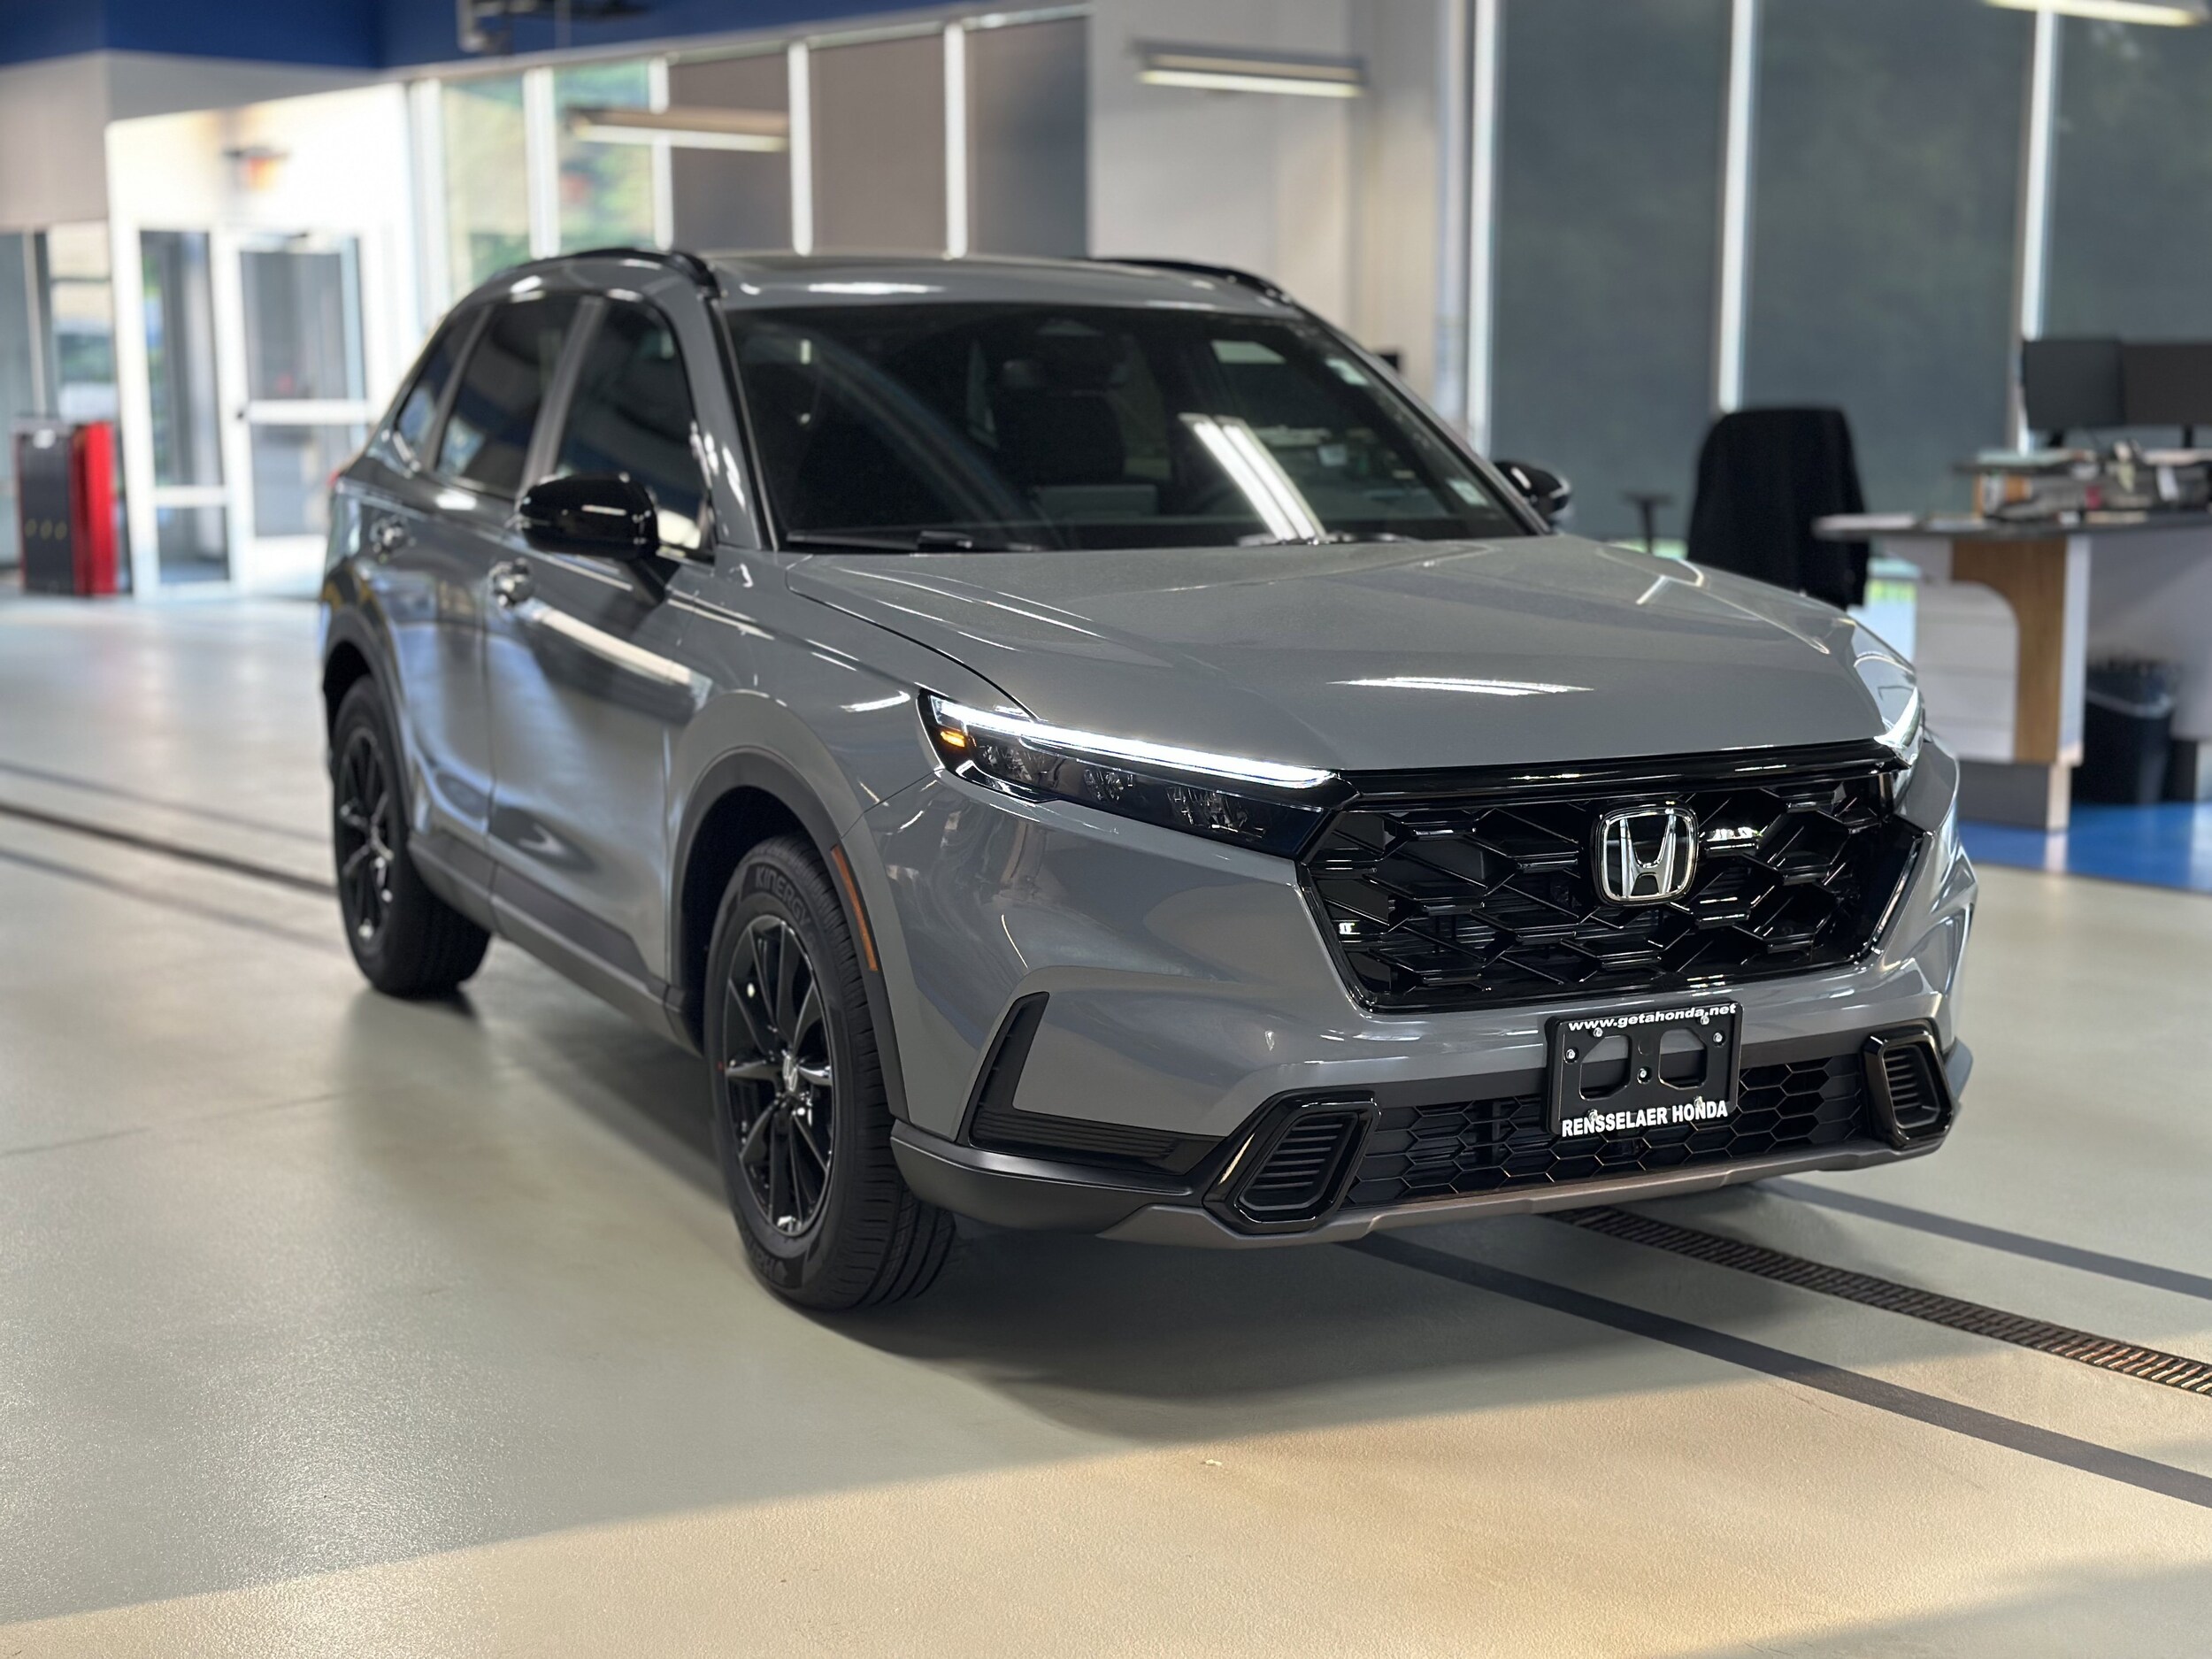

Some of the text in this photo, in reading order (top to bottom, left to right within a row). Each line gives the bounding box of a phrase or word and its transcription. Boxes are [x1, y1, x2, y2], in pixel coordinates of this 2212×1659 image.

[755, 866, 811, 926] KINERGY
[1568, 1003, 1737, 1032] www.getahonda.net
[1562, 1100, 1728, 1138] RENSSELAER HONDA
